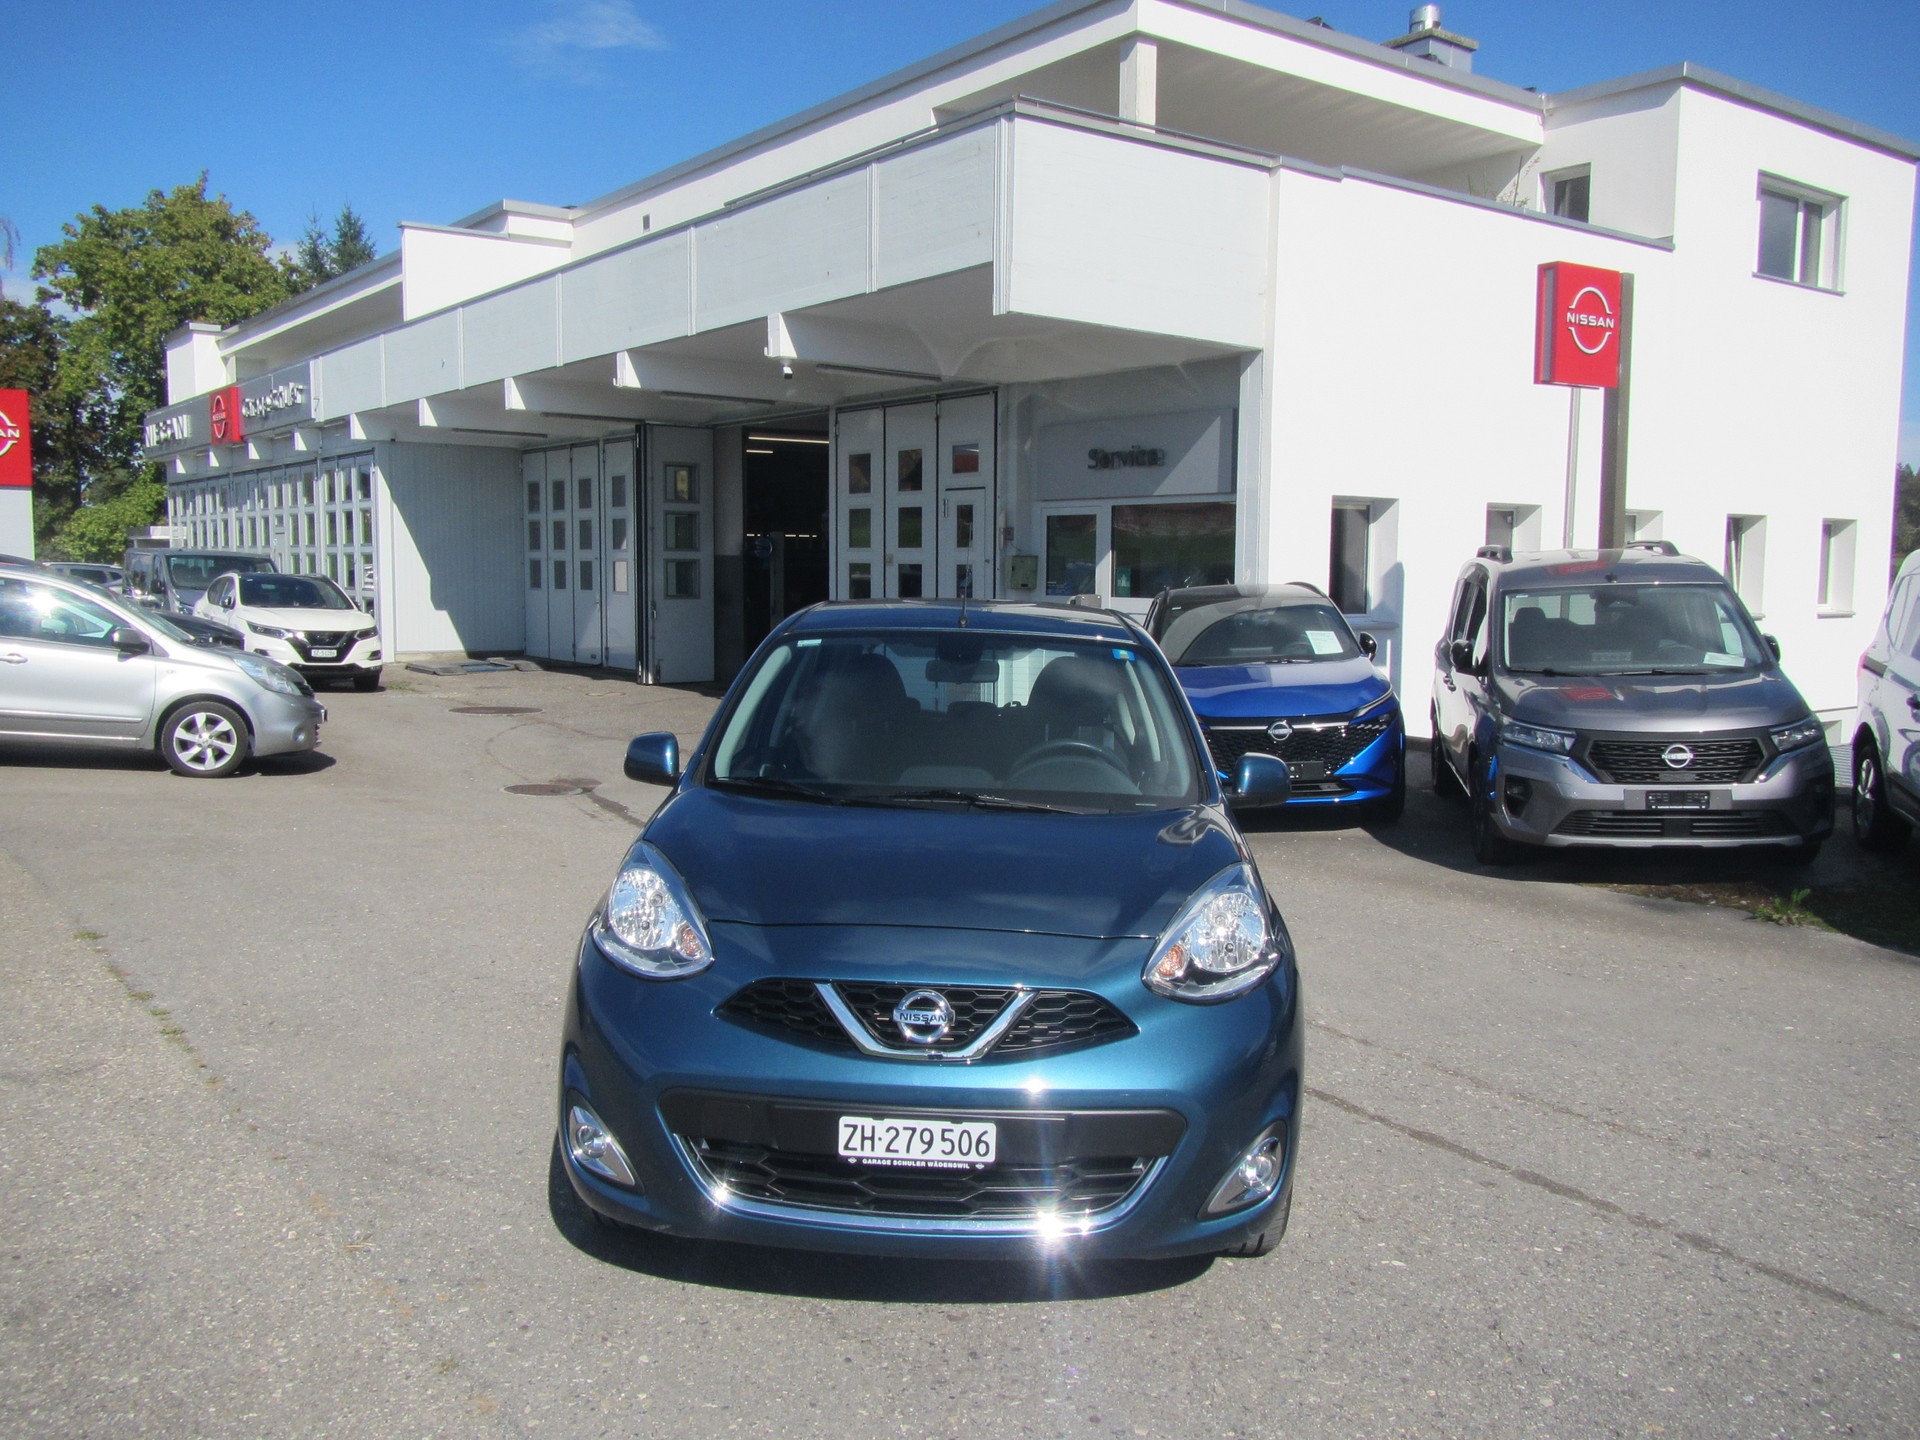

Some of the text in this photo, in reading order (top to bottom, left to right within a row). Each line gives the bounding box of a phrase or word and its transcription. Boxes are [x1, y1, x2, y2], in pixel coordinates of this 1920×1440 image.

[1566, 312, 1615, 329] NISSAN
[1087, 445, 1165, 470] Service
[900, 1012, 947, 1023] NISSAN
[862, 1158, 892, 1166] GARAGE
[893, 1159, 926, 1168] SCHULER
